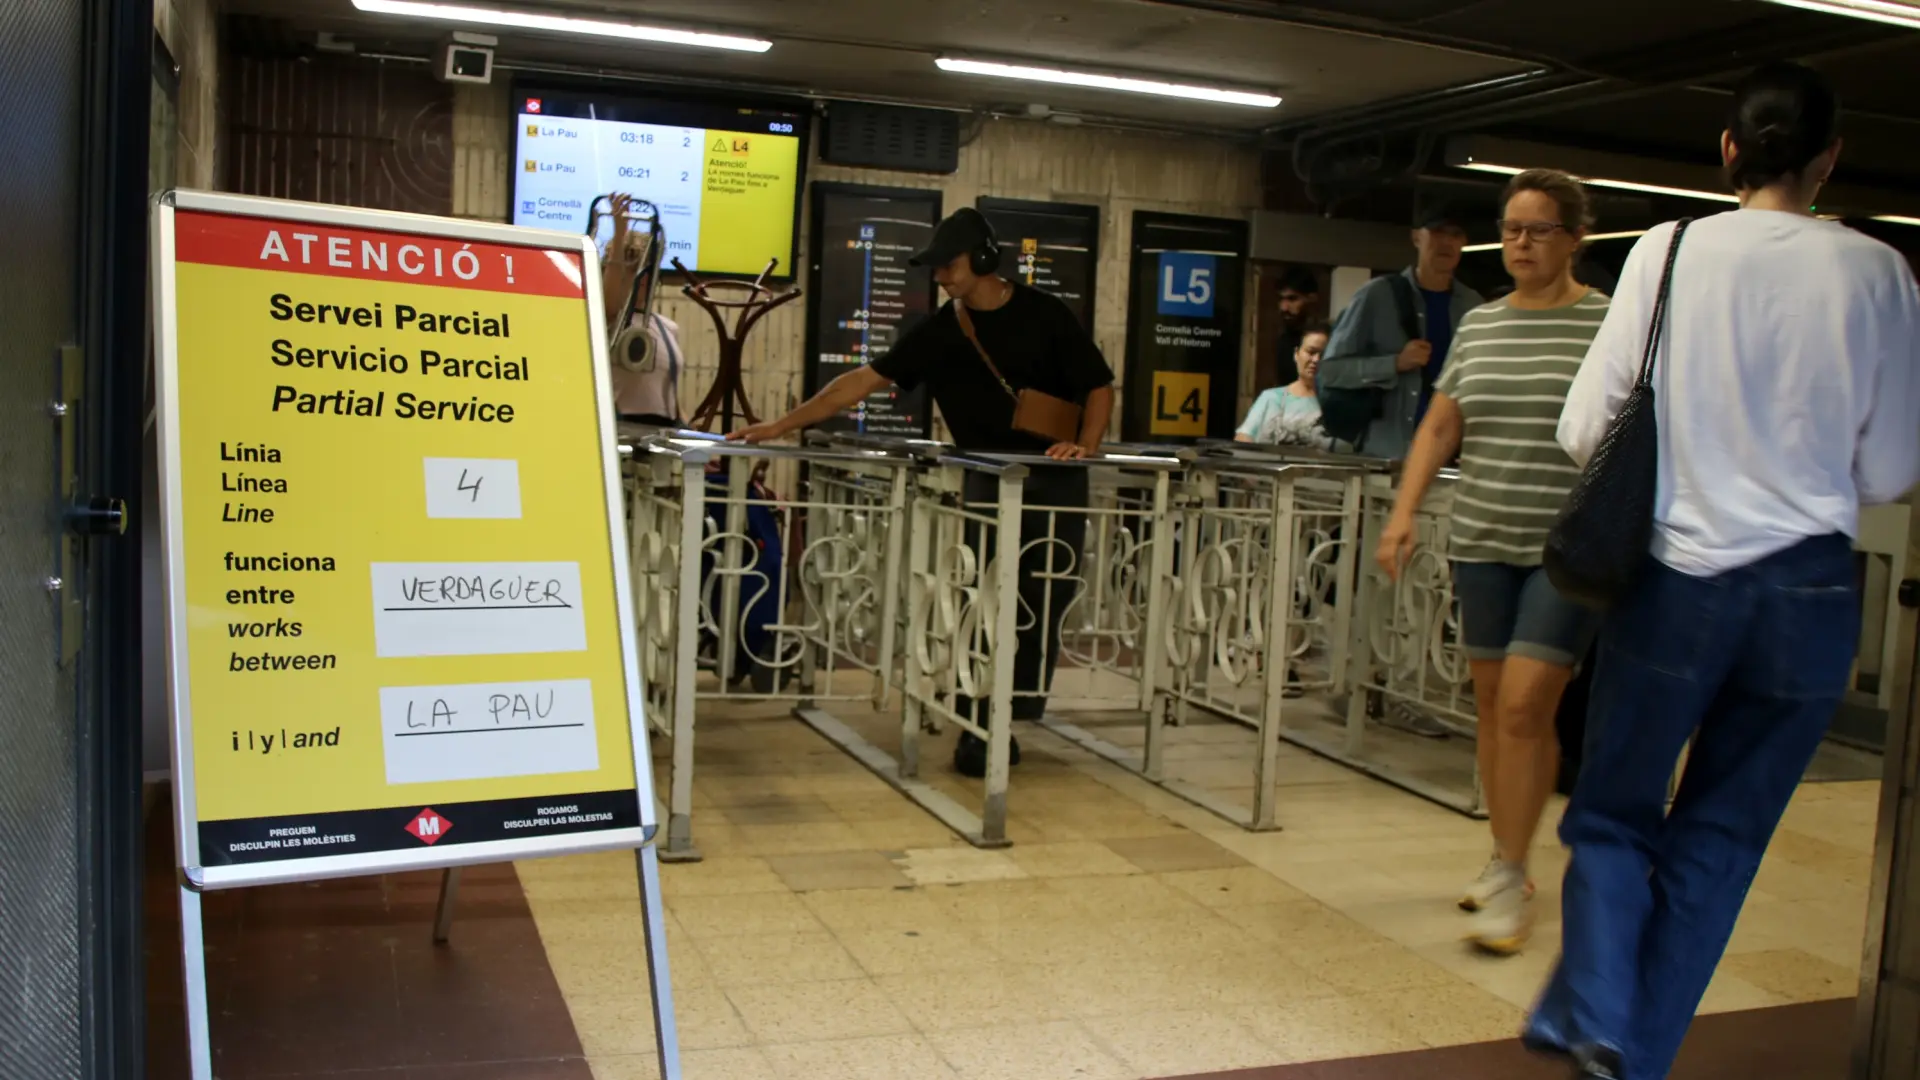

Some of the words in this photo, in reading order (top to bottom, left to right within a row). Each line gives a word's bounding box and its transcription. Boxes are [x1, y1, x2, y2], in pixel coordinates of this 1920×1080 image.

[542, 126, 555, 136] La
[558, 128, 577, 138] Pau
[620, 131, 654, 144] 03:18
[769, 122, 793, 133] 09:50
[683, 137, 691, 147] 2
[733, 141, 748, 152] L4
[540, 162, 553, 172] La
[556, 163, 576, 173] Pau
[618, 166, 650, 178] 06:21
[681, 171, 690, 181] 2
[537, 210, 572, 221] Centre
[259, 229, 481, 280] ATENCIÓ
[669, 240, 692, 250] min
[1163, 265, 1211, 305] L5
[269, 293, 382, 329] Servei
[395, 304, 510, 338] Parcial
[1156, 335, 1171, 345] Vall
[1173, 336, 1211, 348] d'Hebron
[1193, 326, 1222, 337] Centre
[271, 338, 409, 374] Servicio
[420, 349, 529, 381] Parcial
[271, 385, 385, 417] Partial
[394, 392, 515, 424] Service
[1156, 385, 1203, 422] L4
[220, 441, 282, 464] Línia
[221, 471, 288, 494] Línea
[457, 468, 484, 503] 4
[222, 502, 275, 524] Line
[223, 551, 336, 572] funciona
[225, 585, 295, 605] entre
[402, 575, 570, 607] VERDAGUER
[227, 617, 303, 638] works
[229, 651, 337, 672] between
[406, 698, 458, 729] LA
[488, 689, 555, 725] PAU
[537, 804, 579, 816] ROGAMOS
[418, 816, 440, 836] M
[503, 818, 550, 830] DISCULPEN
[551, 816, 567, 826] LAS
[568, 812, 614, 825] MOLESTIAS
[269, 826, 316, 838] PREGUEM
[229, 840, 281, 852] DISCULPIN
[282, 838, 301, 848] LES
[303, 833, 357, 846] MOLÈSTIES
